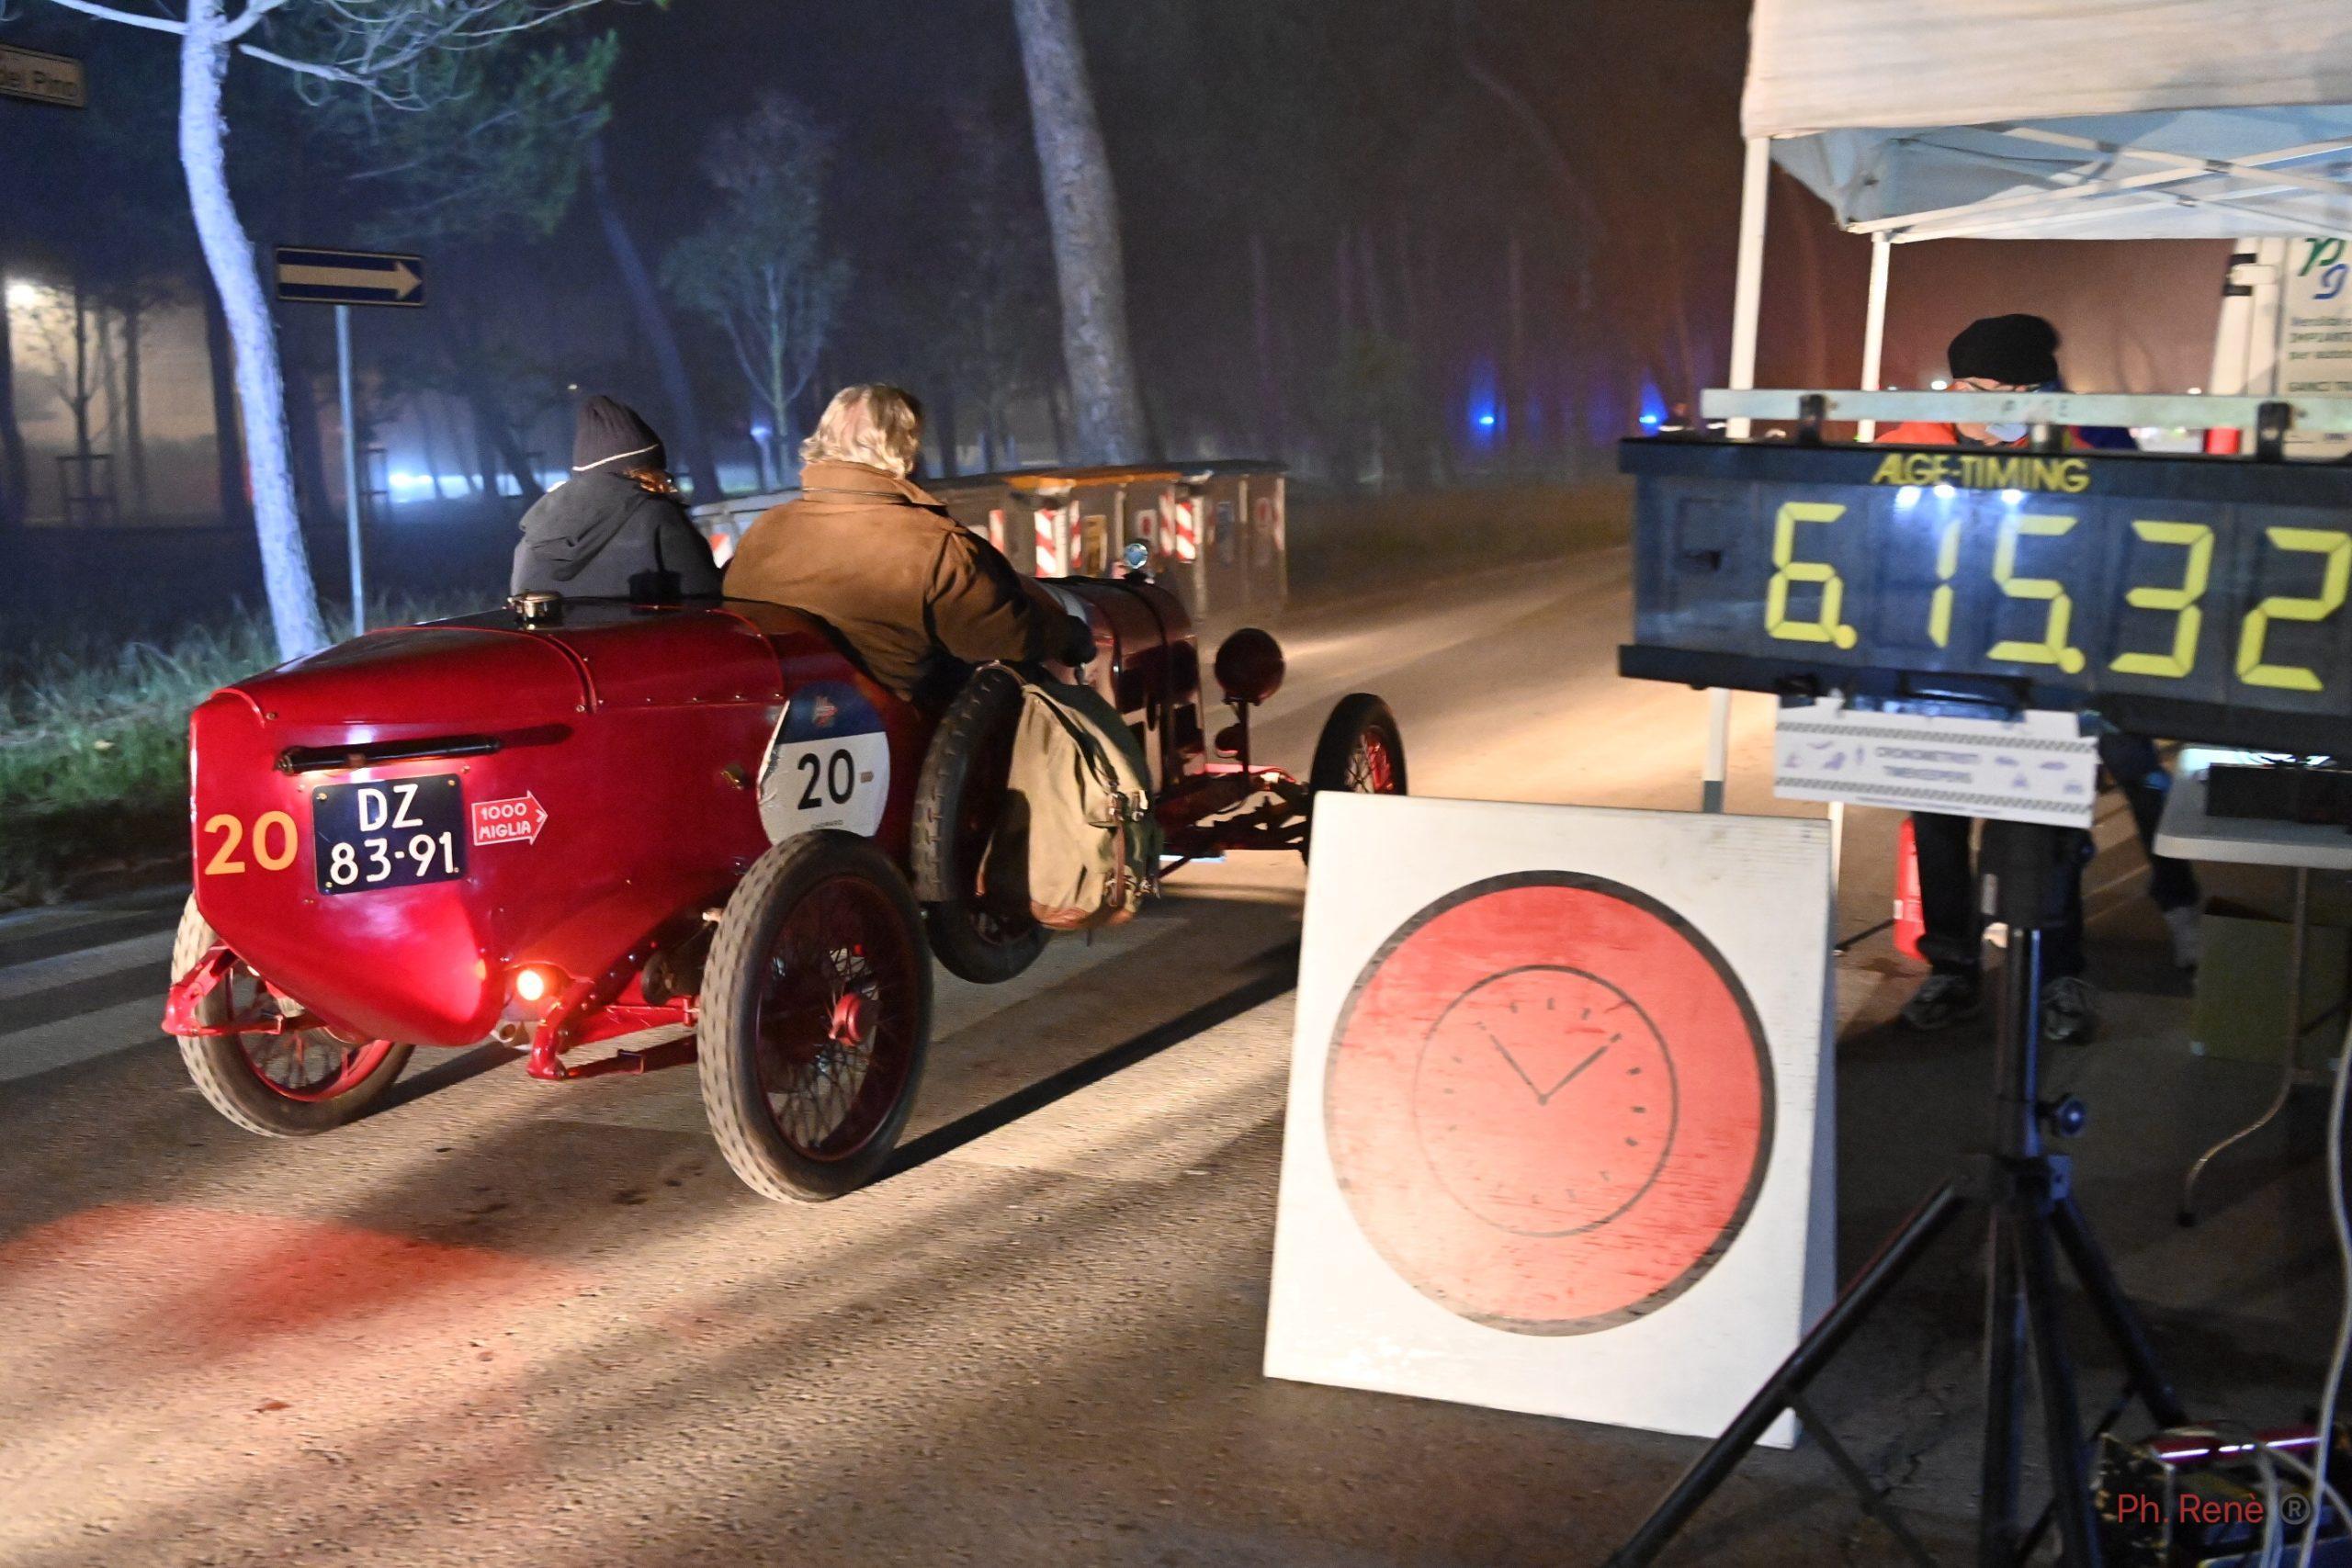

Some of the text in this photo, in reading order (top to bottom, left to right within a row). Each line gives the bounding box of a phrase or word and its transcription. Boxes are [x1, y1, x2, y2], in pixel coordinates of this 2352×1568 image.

[797, 749, 855, 810] 20
[357, 783, 424, 832] DZ
[479, 820, 532, 840] MIGLIA
[481, 802, 527, 821] 1000
[204, 810, 299, 875] 20
[330, 831, 455, 886] 83-91
